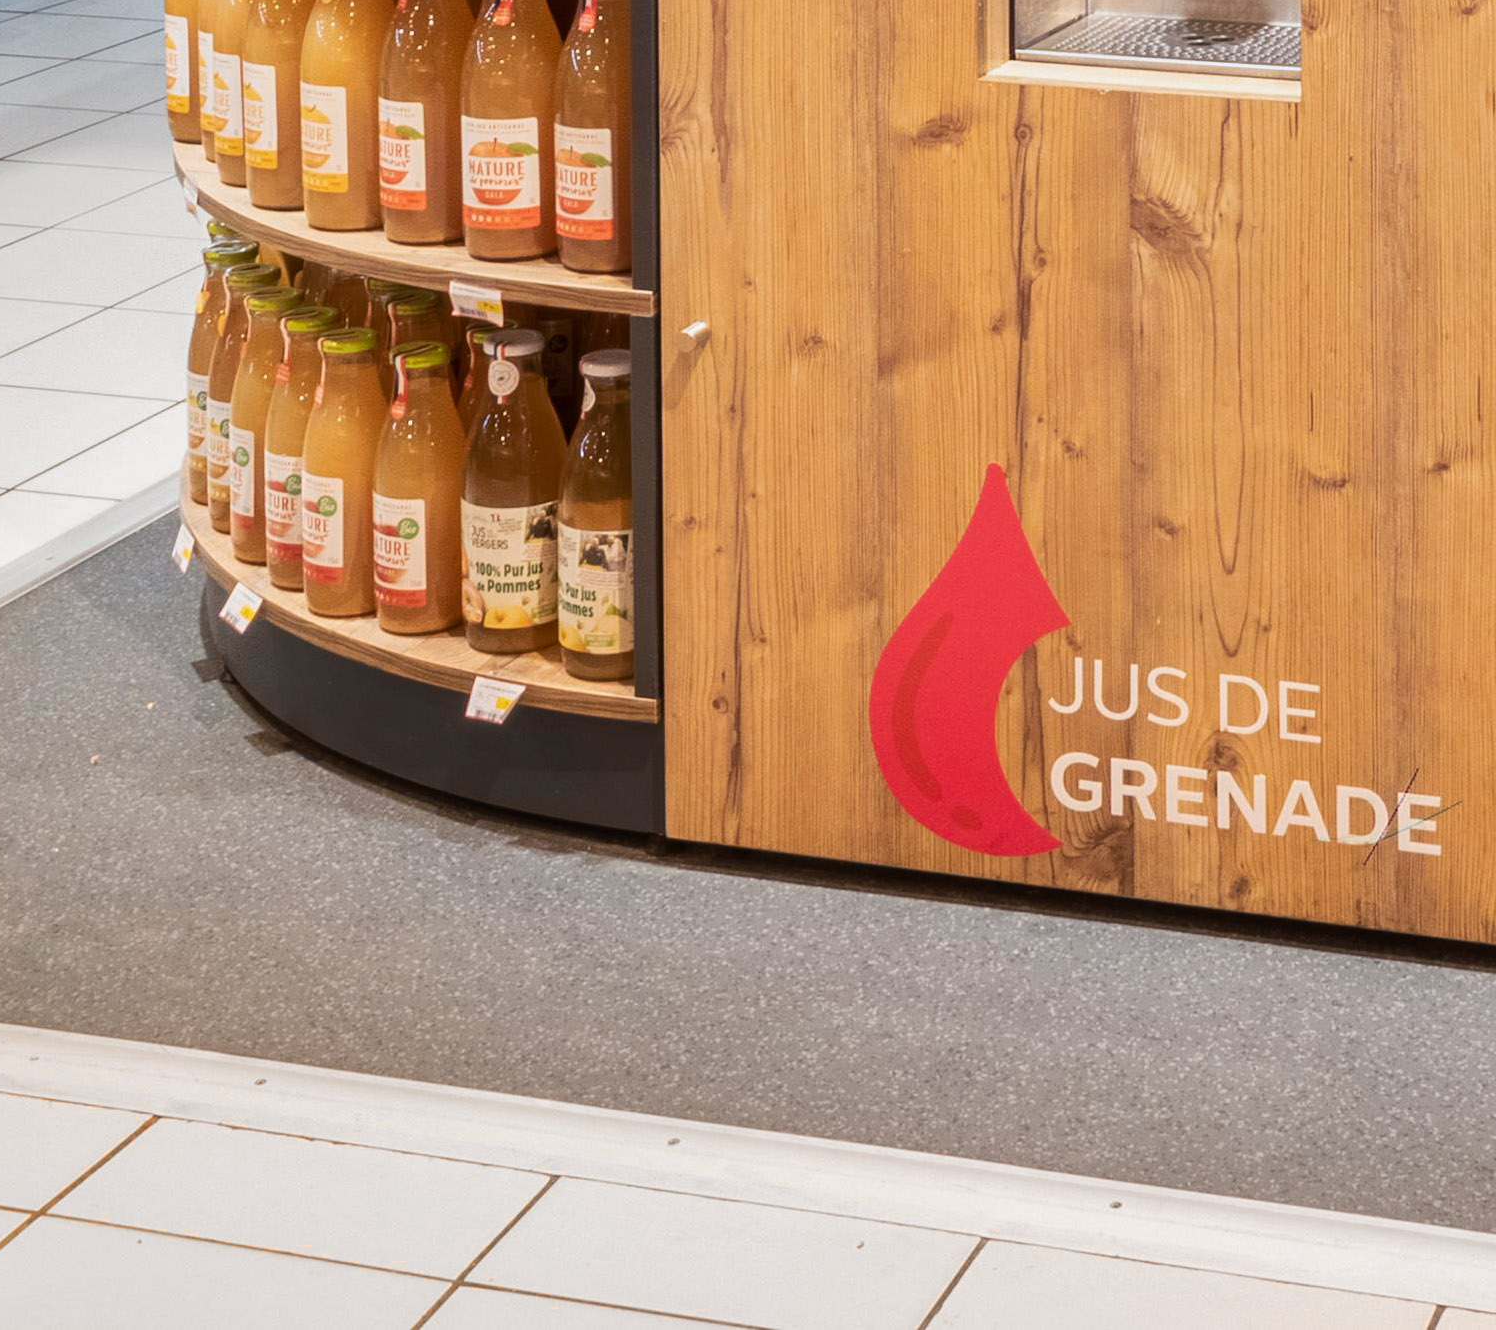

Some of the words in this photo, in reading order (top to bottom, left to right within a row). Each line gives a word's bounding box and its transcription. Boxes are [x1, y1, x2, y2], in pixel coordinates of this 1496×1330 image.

[468, 159, 526, 177] NATURE
[475, 561, 501, 578] 100%
[504, 562, 524, 578] Pur
[487, 578, 541, 594] Pommes
[1048, 654, 1191, 728] JUS
[1219, 672, 1323, 745] DE
[1048, 752, 1442, 858] GRENADE
